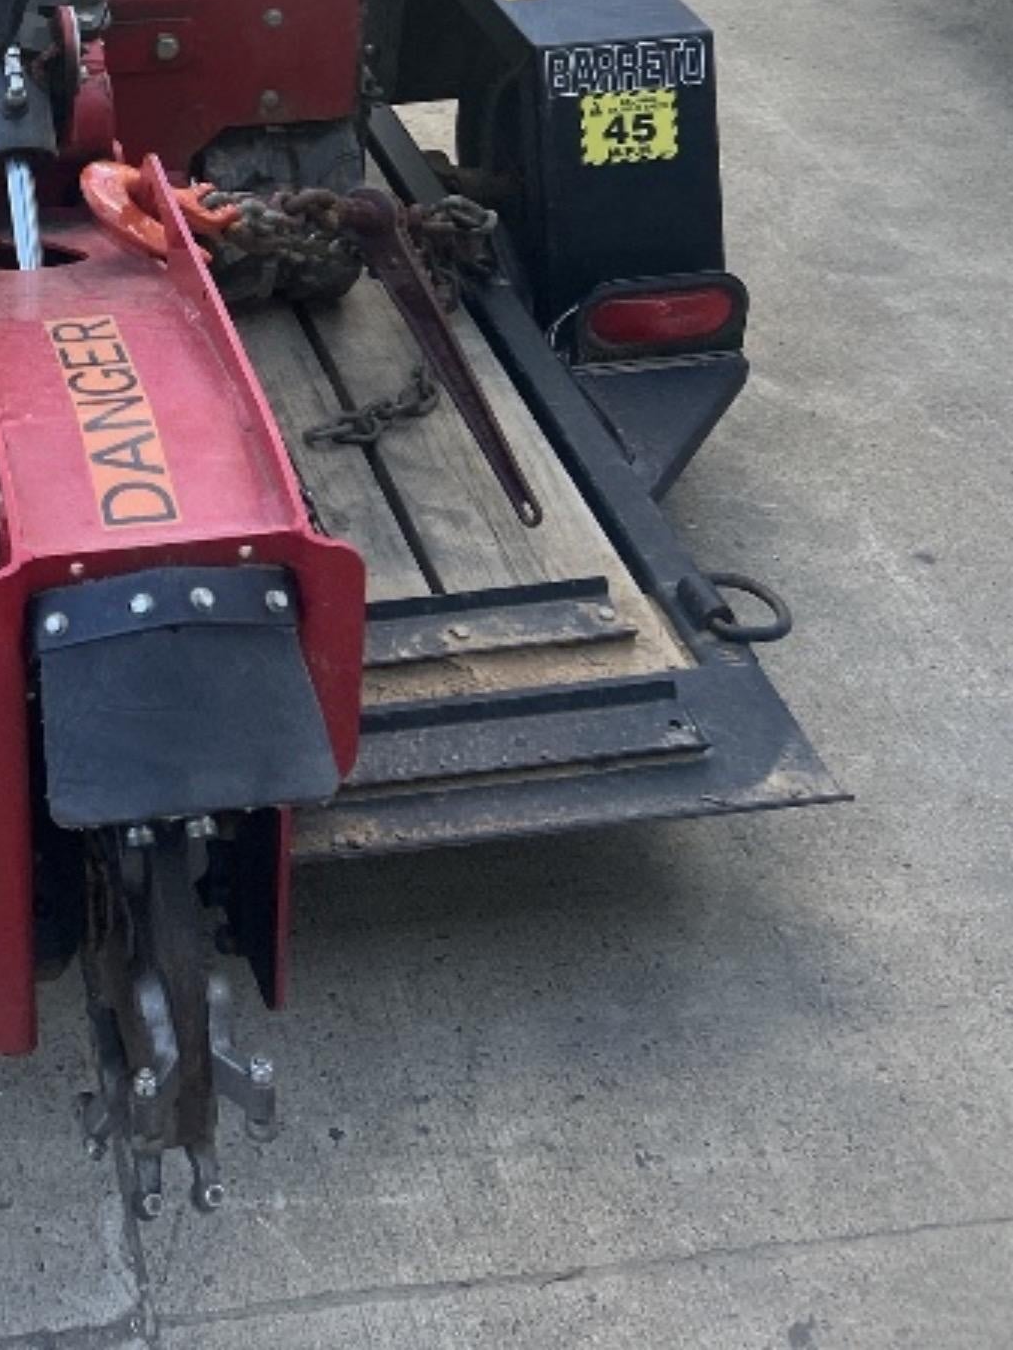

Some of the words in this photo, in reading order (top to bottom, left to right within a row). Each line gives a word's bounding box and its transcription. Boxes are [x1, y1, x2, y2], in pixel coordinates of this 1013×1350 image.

[545, 39, 705, 98] BARRETO
[602, 112, 657, 144] 45
[51, 317, 178, 527] DANGER
